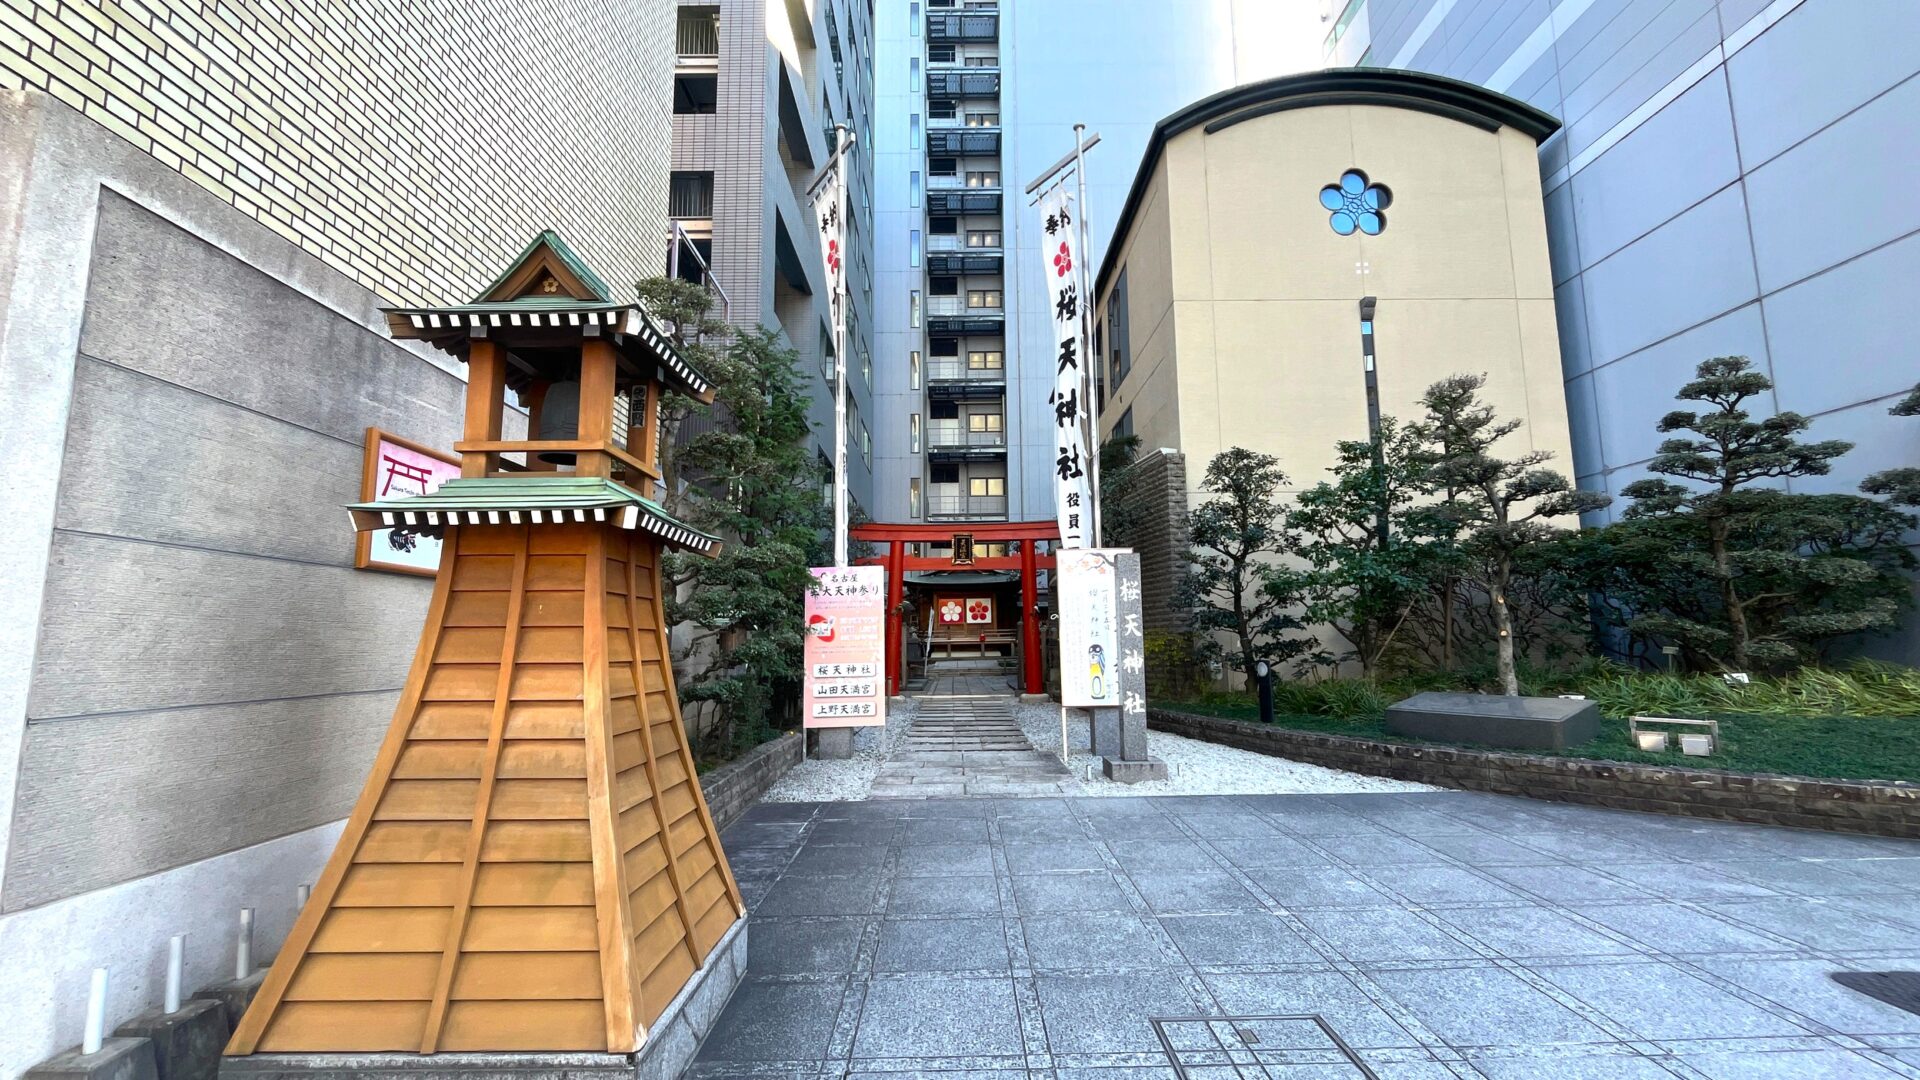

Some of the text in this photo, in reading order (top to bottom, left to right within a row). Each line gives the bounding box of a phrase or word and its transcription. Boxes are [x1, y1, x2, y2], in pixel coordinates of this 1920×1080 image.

[1056, 280, 1084, 550] 桜天神社 役員一
[831, 573, 859, 583] 名古屋
[1120, 578, 1145, 715] 桜天神社
[818, 664, 872, 676] 桜天神社
[817, 684, 871, 696] 山田天満宮
[817, 704, 871, 716] 上野天満宮
